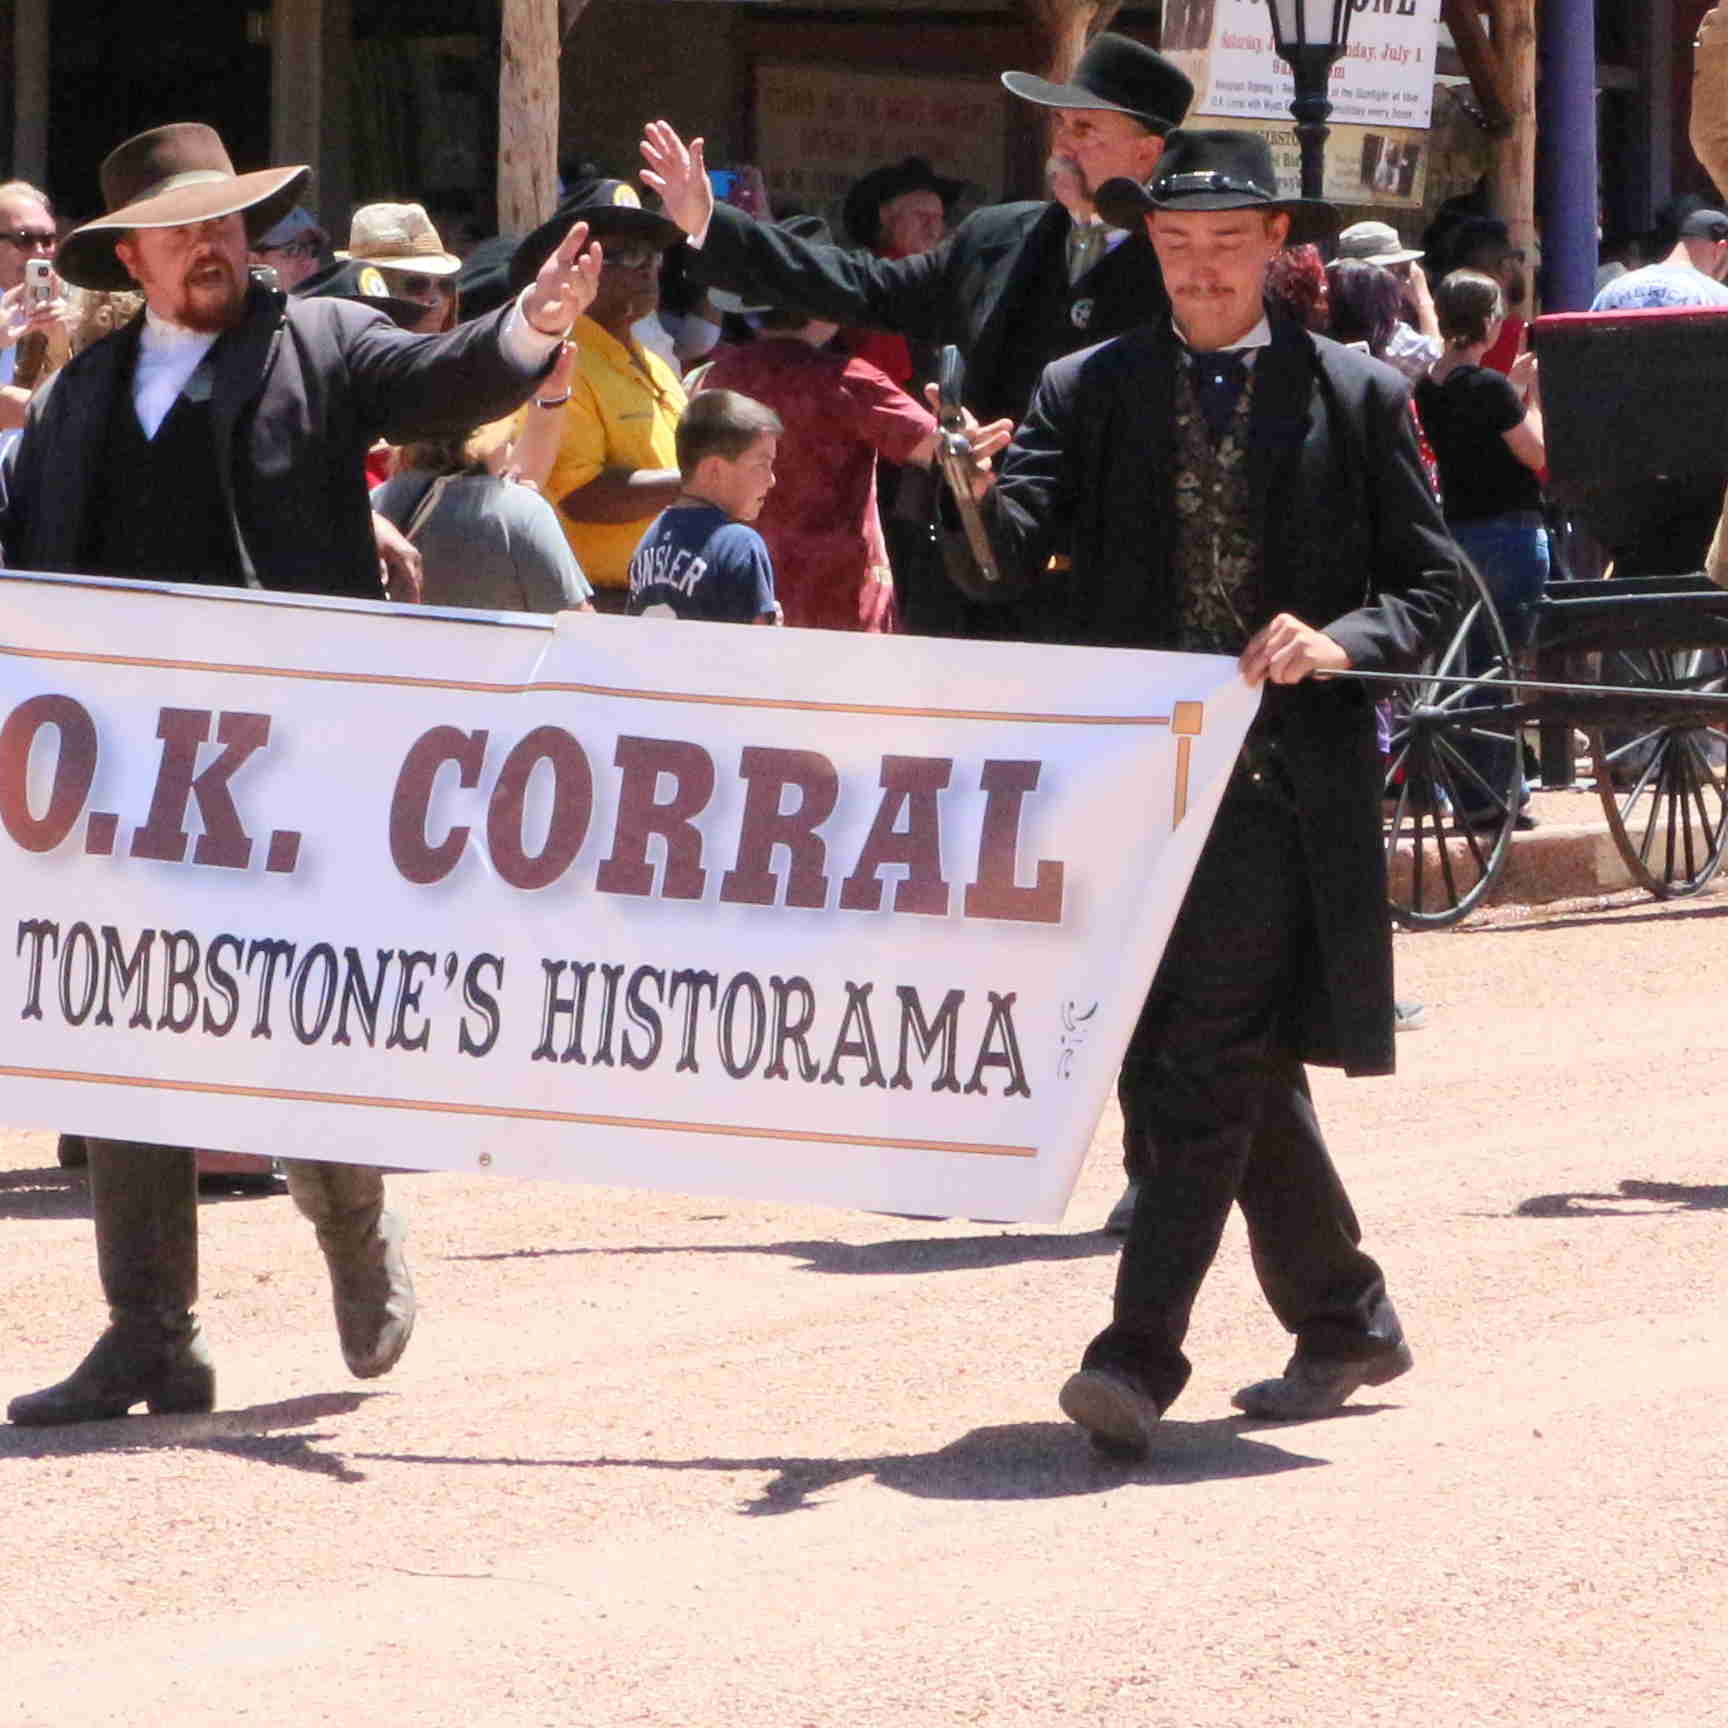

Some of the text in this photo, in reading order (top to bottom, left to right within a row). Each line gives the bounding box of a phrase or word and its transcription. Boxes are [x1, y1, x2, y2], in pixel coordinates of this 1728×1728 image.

[387, 723, 1066, 926] CORRAL
[14, 917, 1032, 1100] TOMBSTONE'S HISTORAMA
